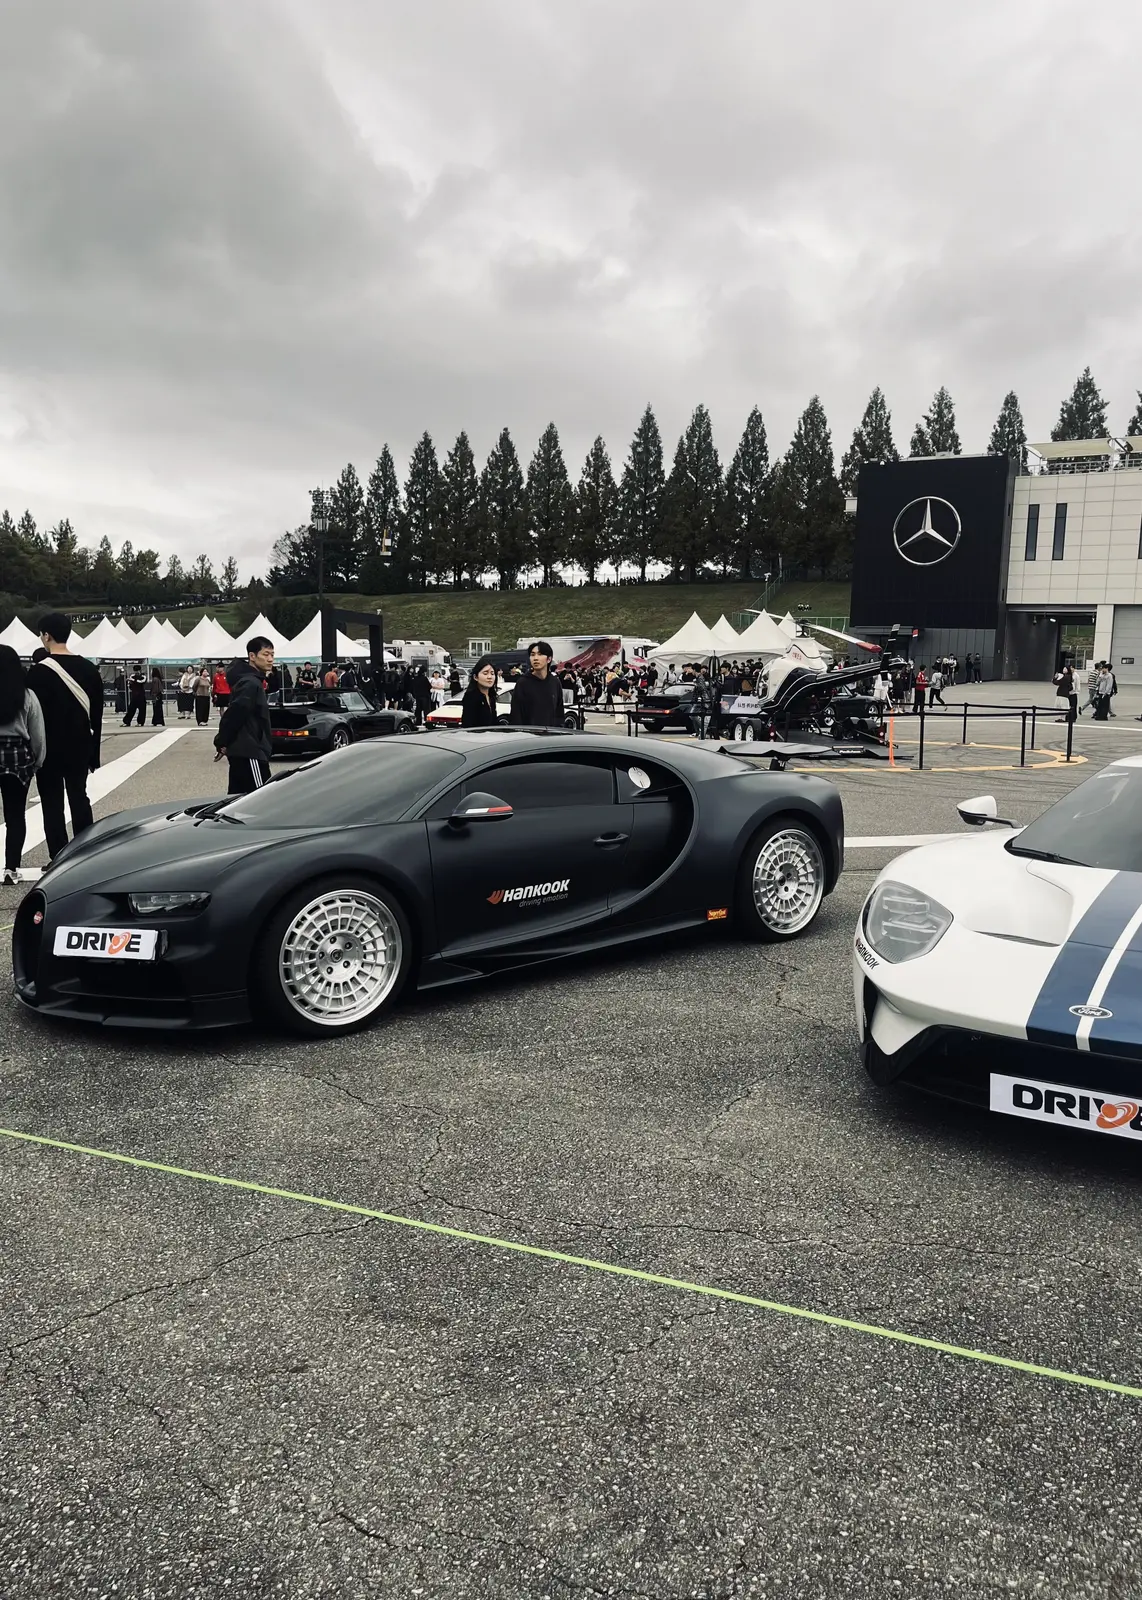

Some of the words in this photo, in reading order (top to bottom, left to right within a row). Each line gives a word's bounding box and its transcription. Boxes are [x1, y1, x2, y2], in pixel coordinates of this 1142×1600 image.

[518, 898, 542, 908] driving
[542, 893, 569, 903] emotion
[66, 931, 142, 954] DRIVE
[1077, 1006, 1103, 1016] Ford
